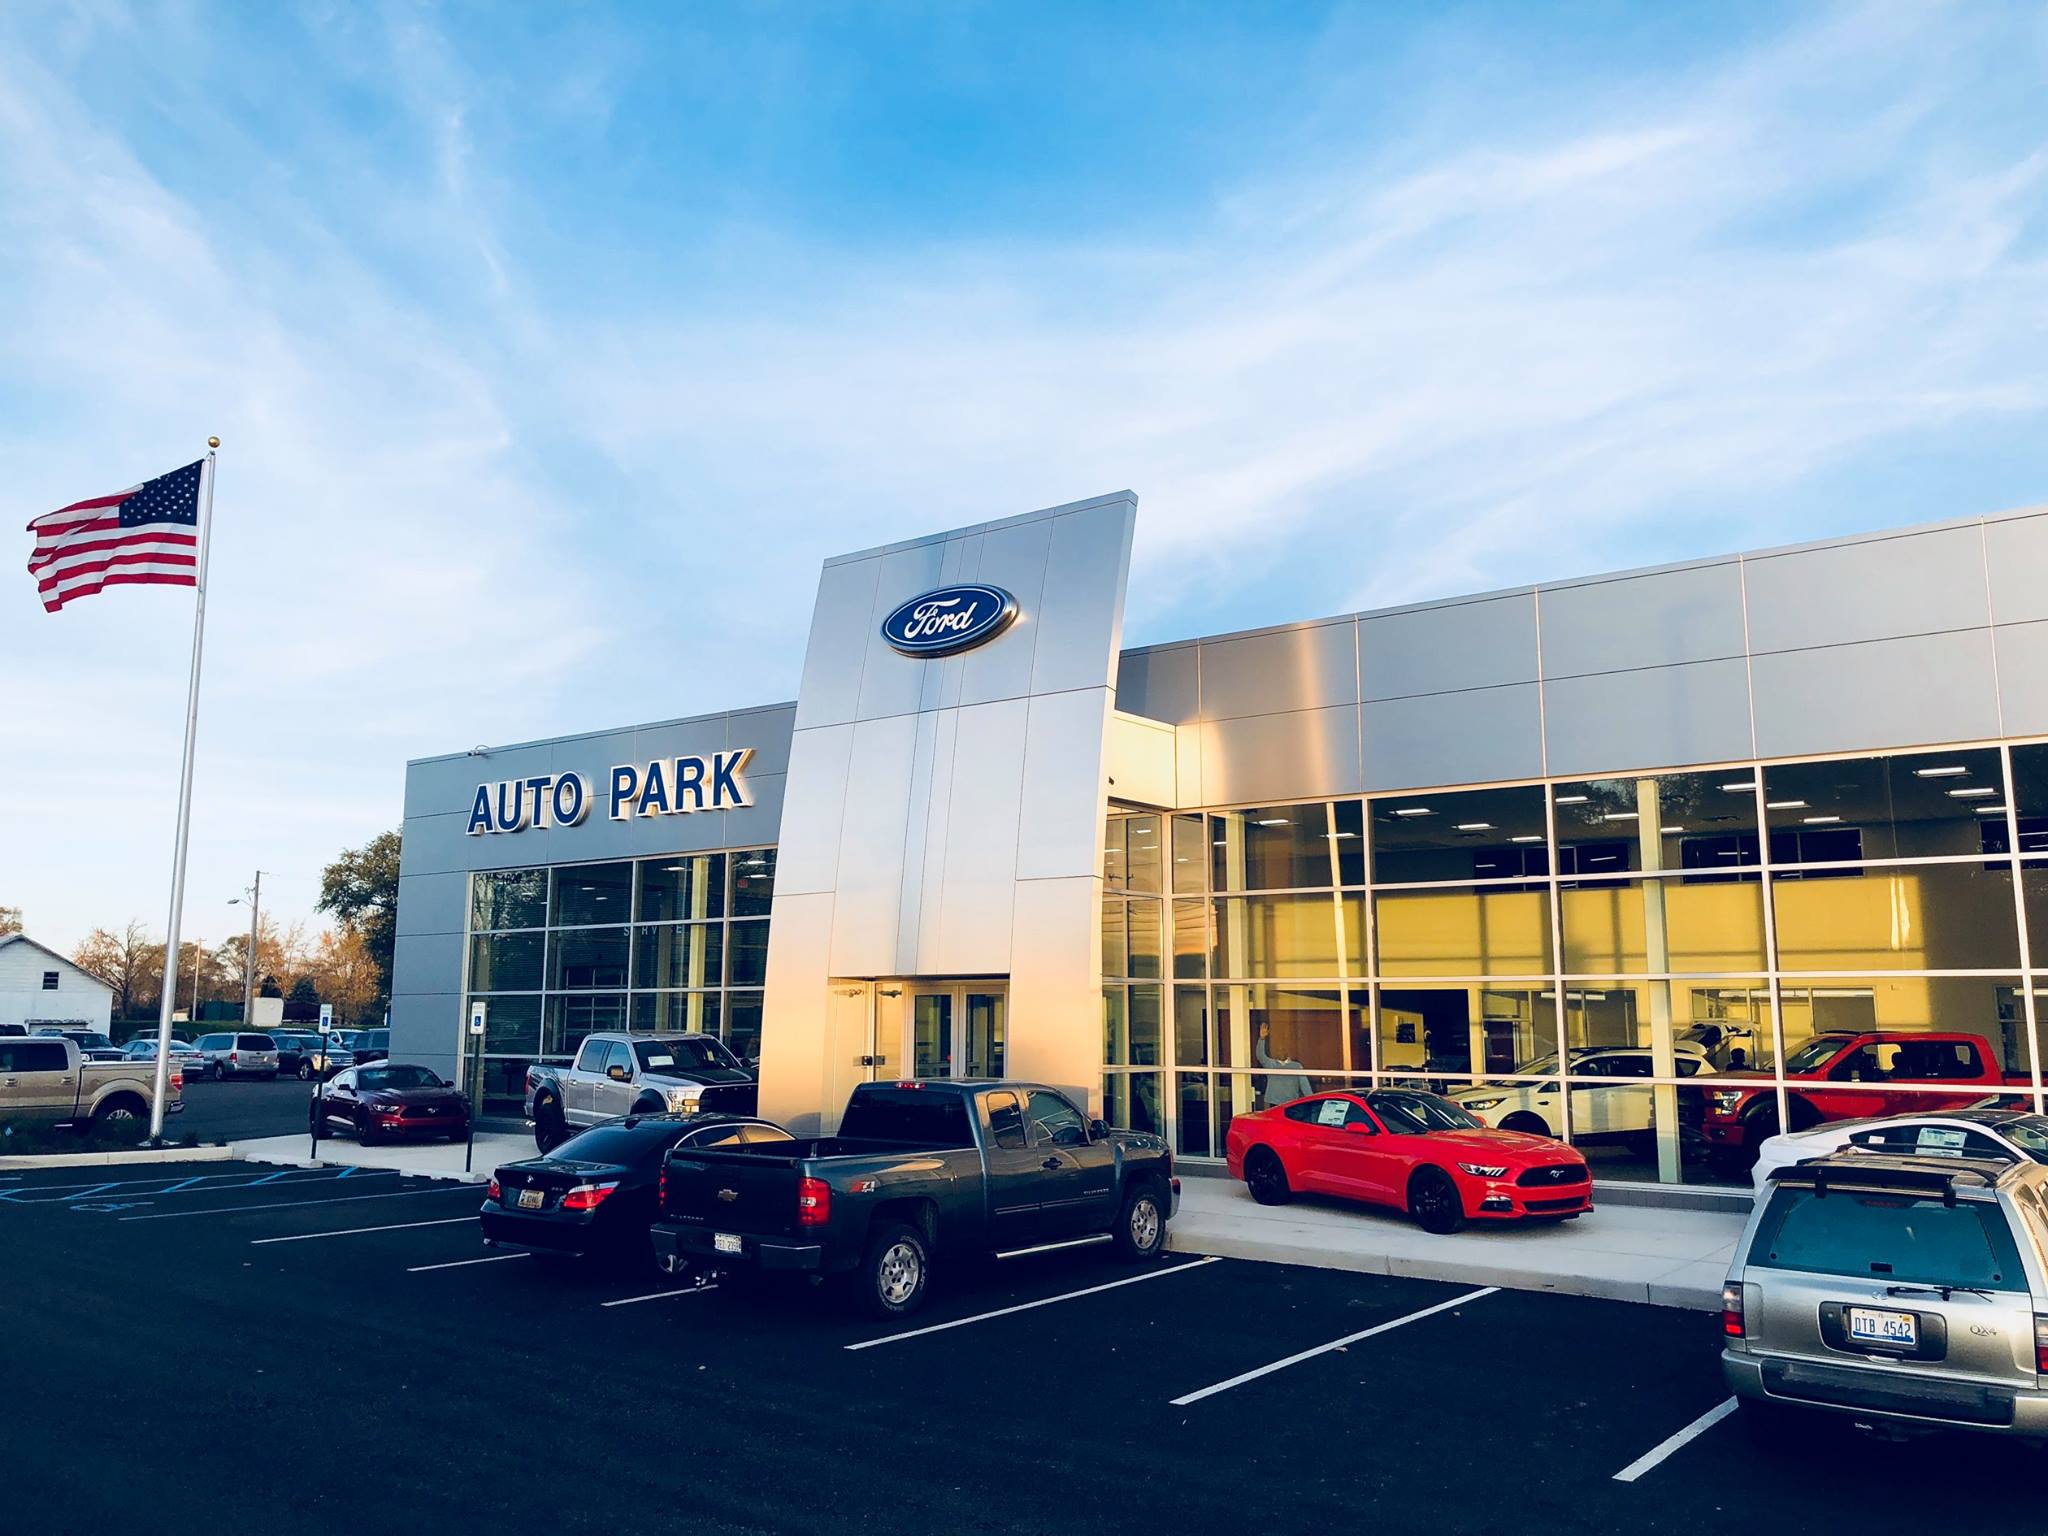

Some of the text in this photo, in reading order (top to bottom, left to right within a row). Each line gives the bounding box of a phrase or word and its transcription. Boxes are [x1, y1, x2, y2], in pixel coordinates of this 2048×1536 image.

[903, 597, 978, 639] Ford
[465, 748, 752, 836] AUTO PARK
[1882, 1320, 1912, 1338] 4542
